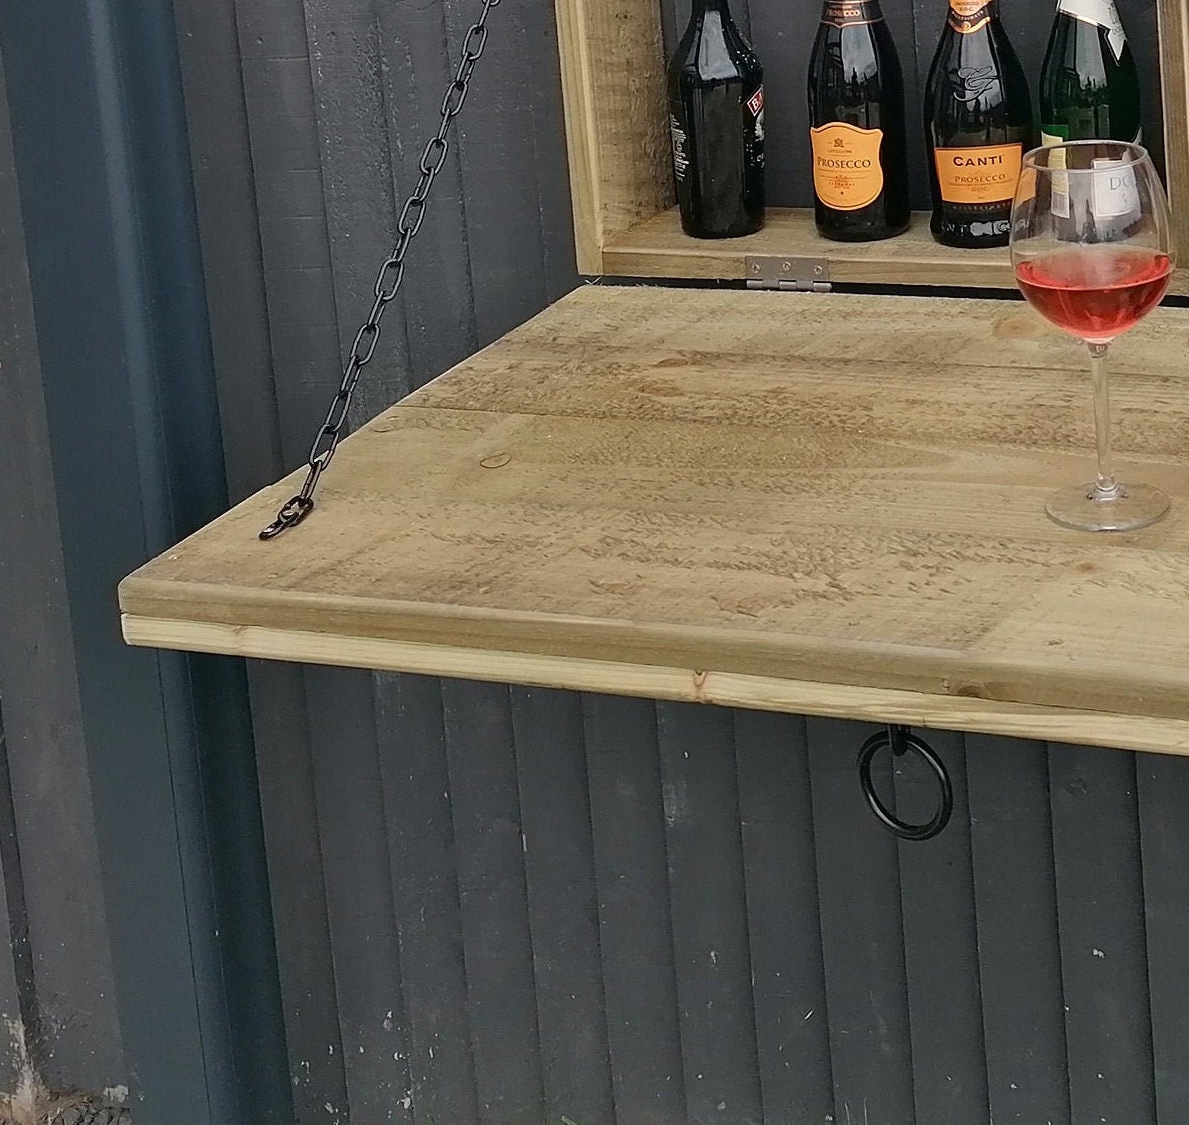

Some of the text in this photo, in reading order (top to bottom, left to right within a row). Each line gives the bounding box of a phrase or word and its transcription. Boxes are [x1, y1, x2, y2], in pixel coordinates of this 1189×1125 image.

[817, 155, 871, 169] PROSECCO
[953, 155, 1003, 167] CANTI
[954, 174, 1006, 183] PROSECCO
